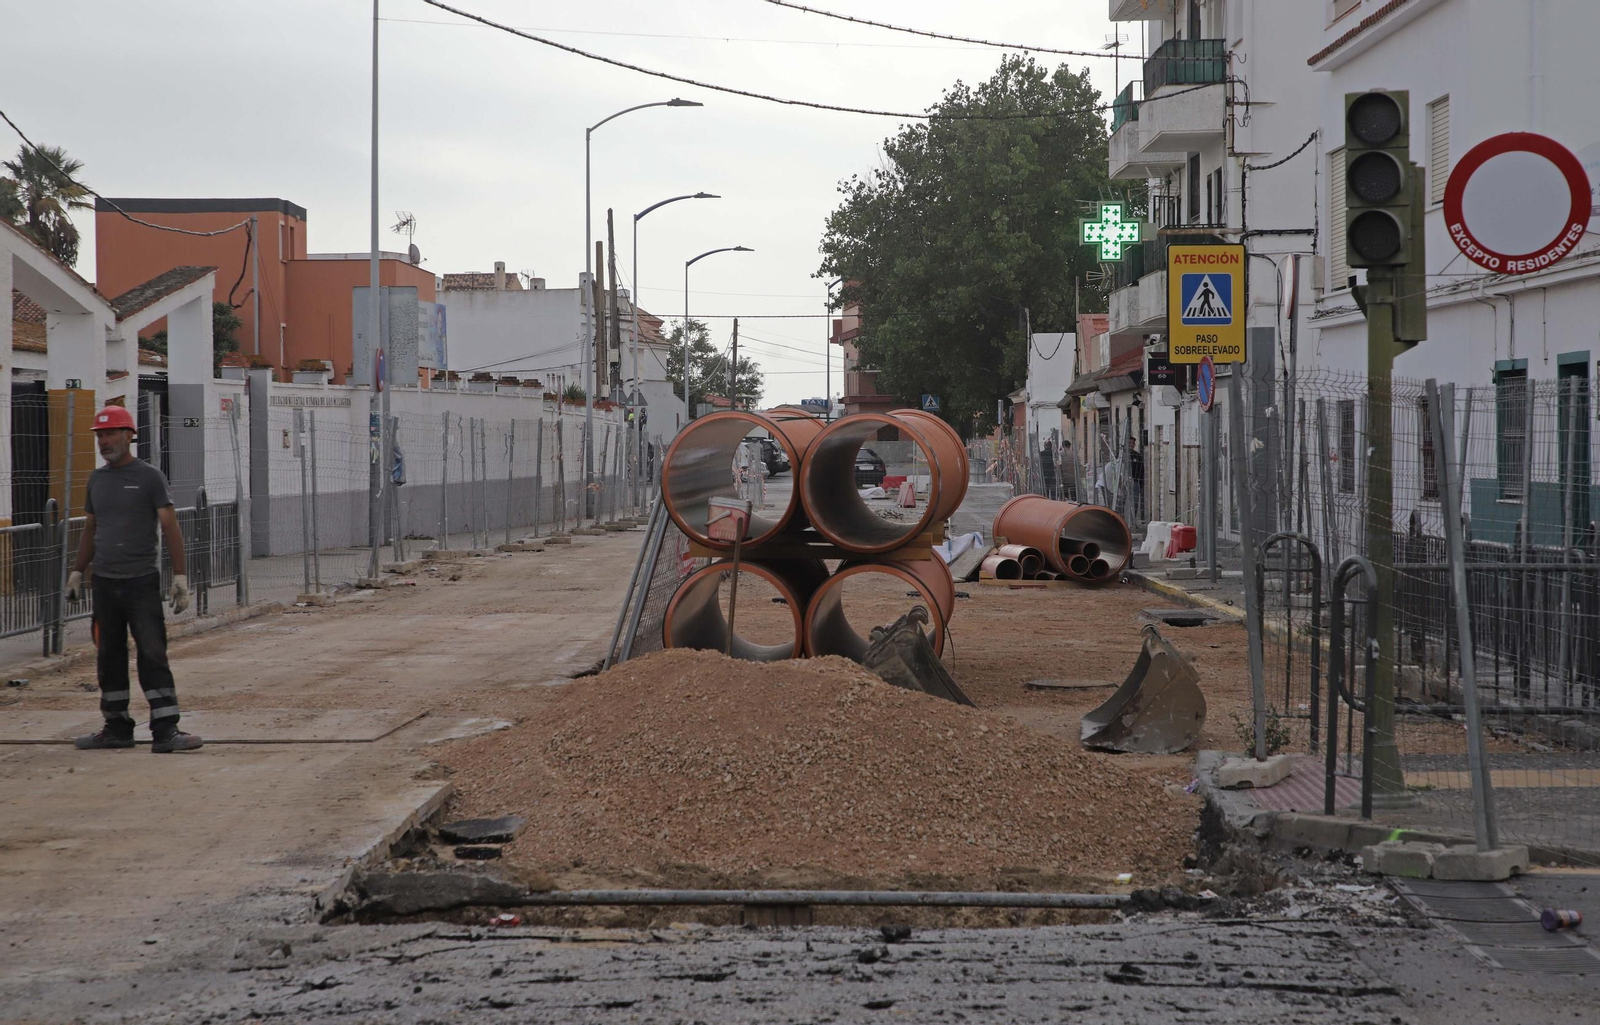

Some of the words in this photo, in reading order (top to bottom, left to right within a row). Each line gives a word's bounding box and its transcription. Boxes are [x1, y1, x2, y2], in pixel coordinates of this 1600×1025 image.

[1450, 222, 1500, 268] EXCEPTO
[1506, 223, 1583, 271] RESIDENTES
[1173, 251, 1239, 264] ATENCIÓN
[1196, 334, 1218, 343] PASO
[1174, 345, 1240, 355] SOBREELEVADO
[66, 379, 80, 388] 91
[184, 418, 198, 427] 93
